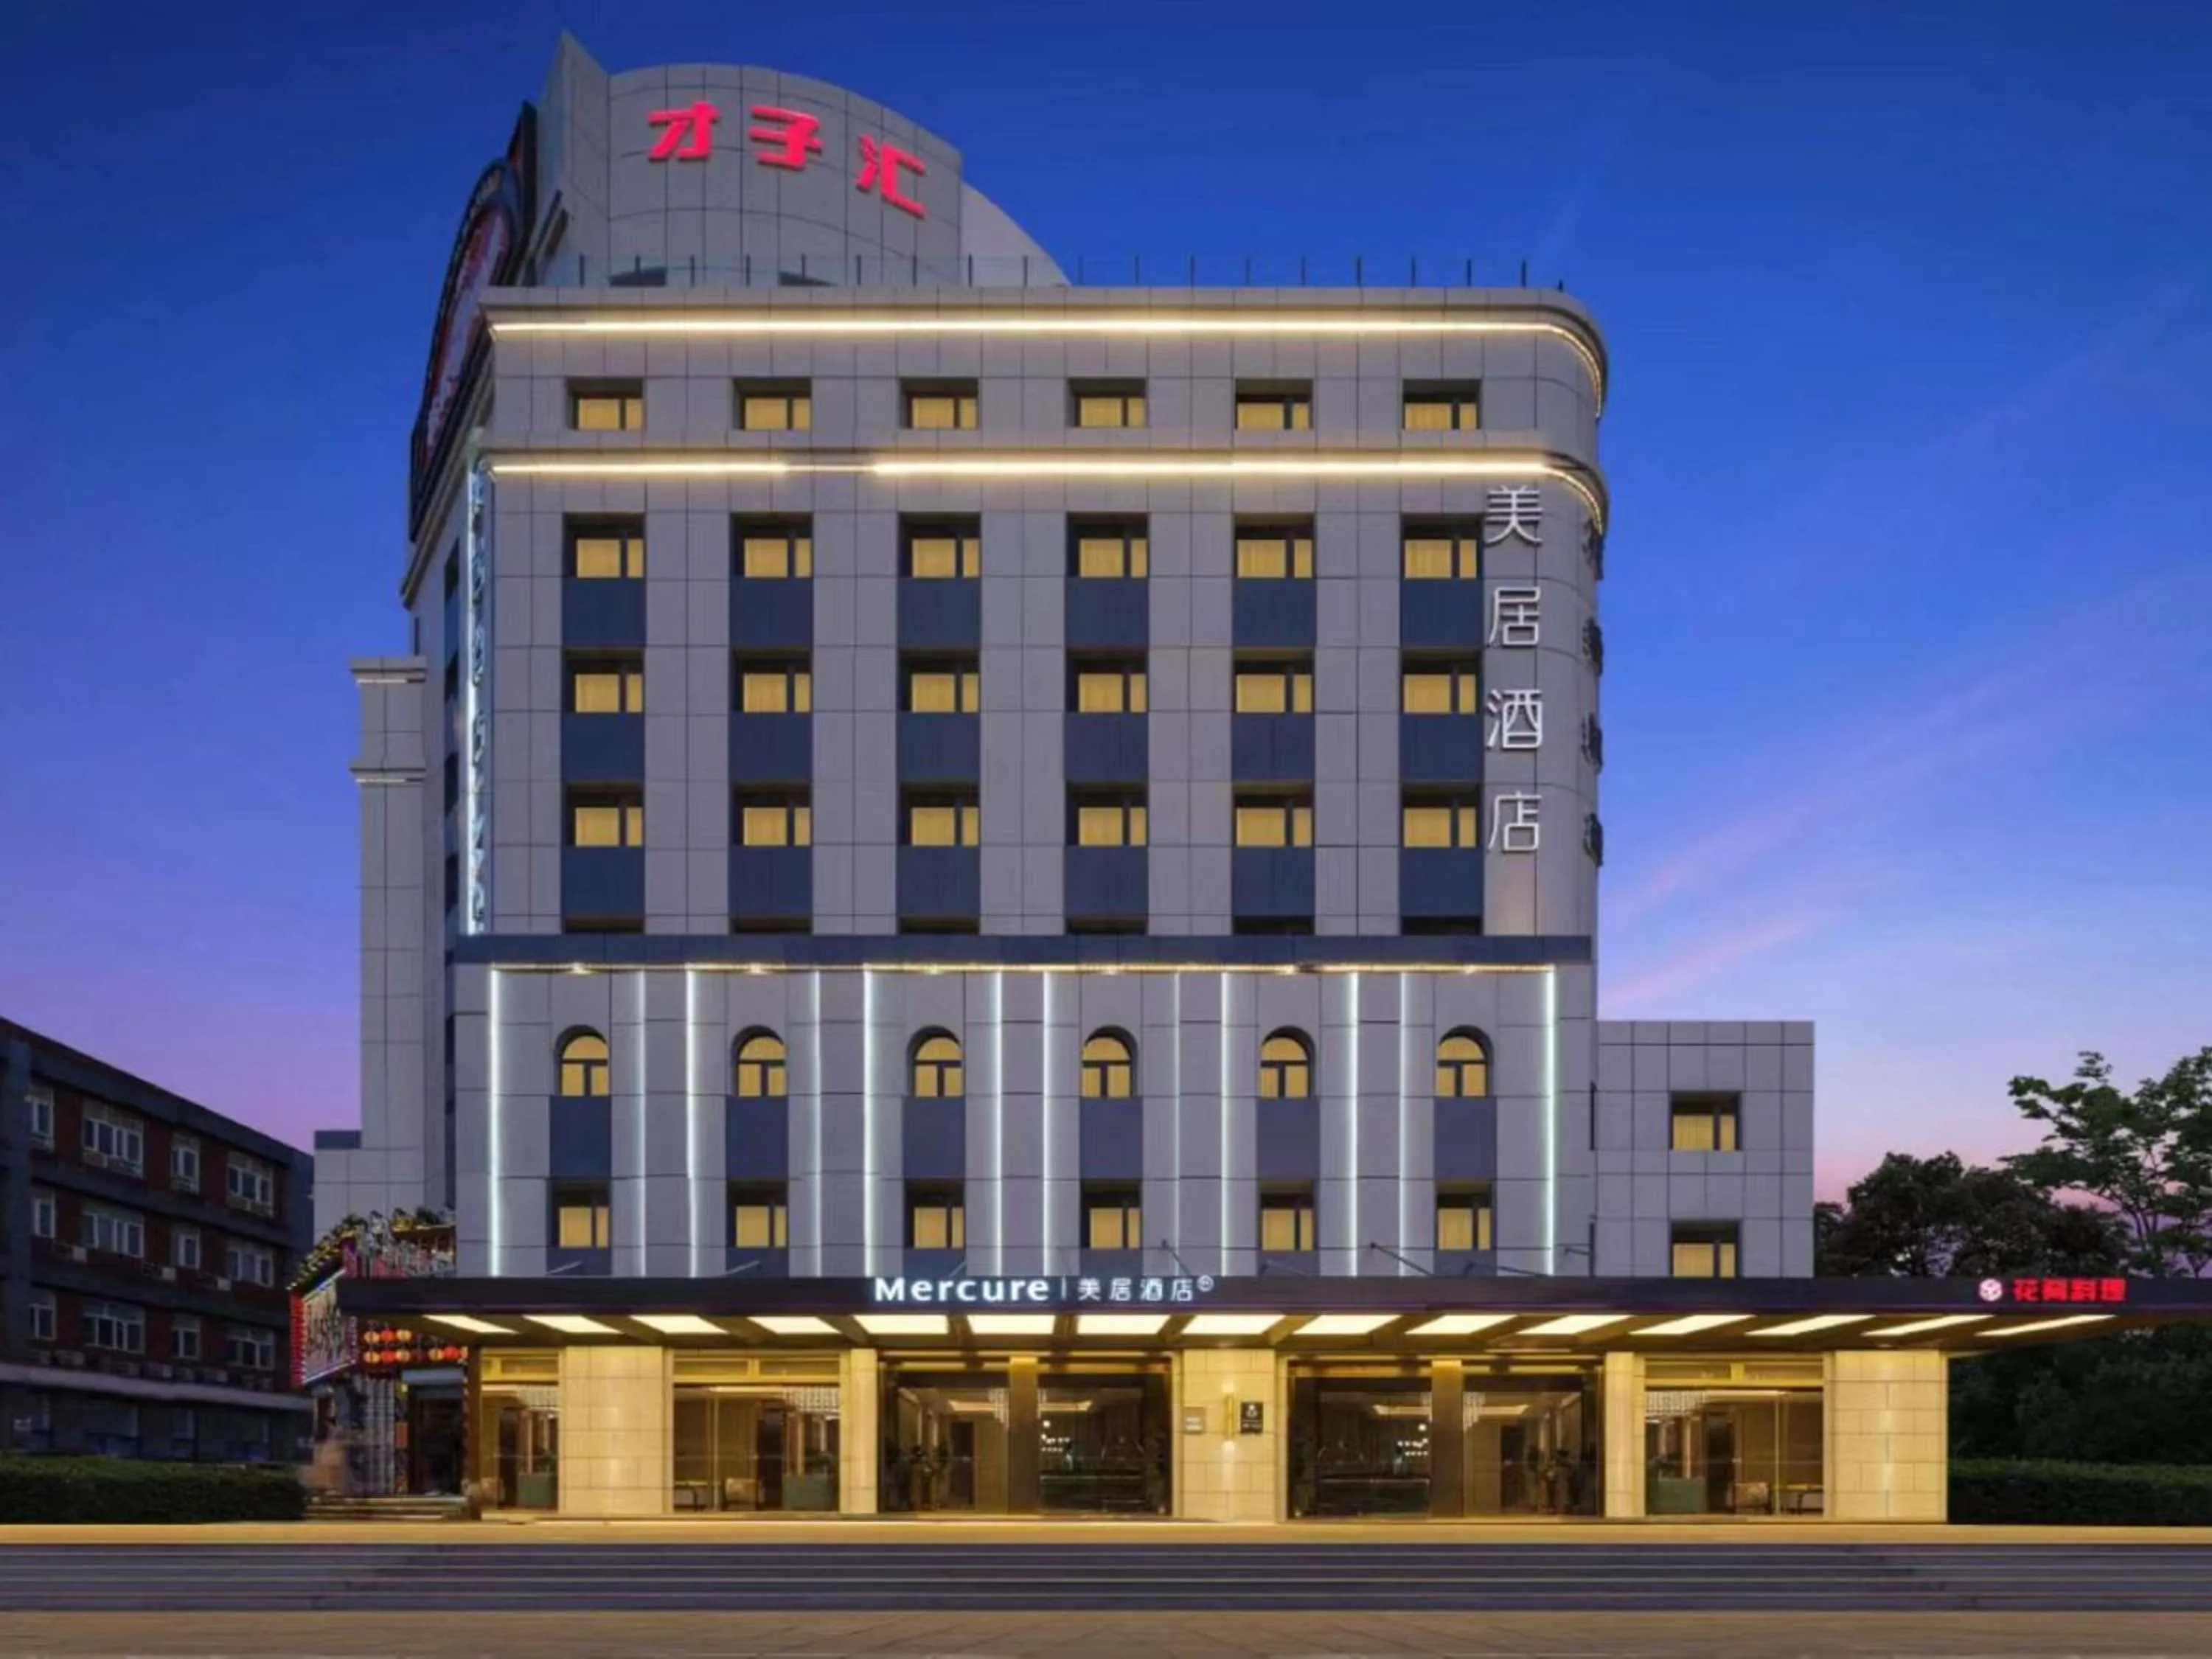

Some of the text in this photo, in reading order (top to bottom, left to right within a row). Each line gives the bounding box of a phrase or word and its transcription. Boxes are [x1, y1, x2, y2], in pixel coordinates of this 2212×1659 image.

[647, 100, 926, 218] 才子汇
[1485, 485, 1543, 852] 美居酒店
[874, 1277, 1050, 1302] Mercure
